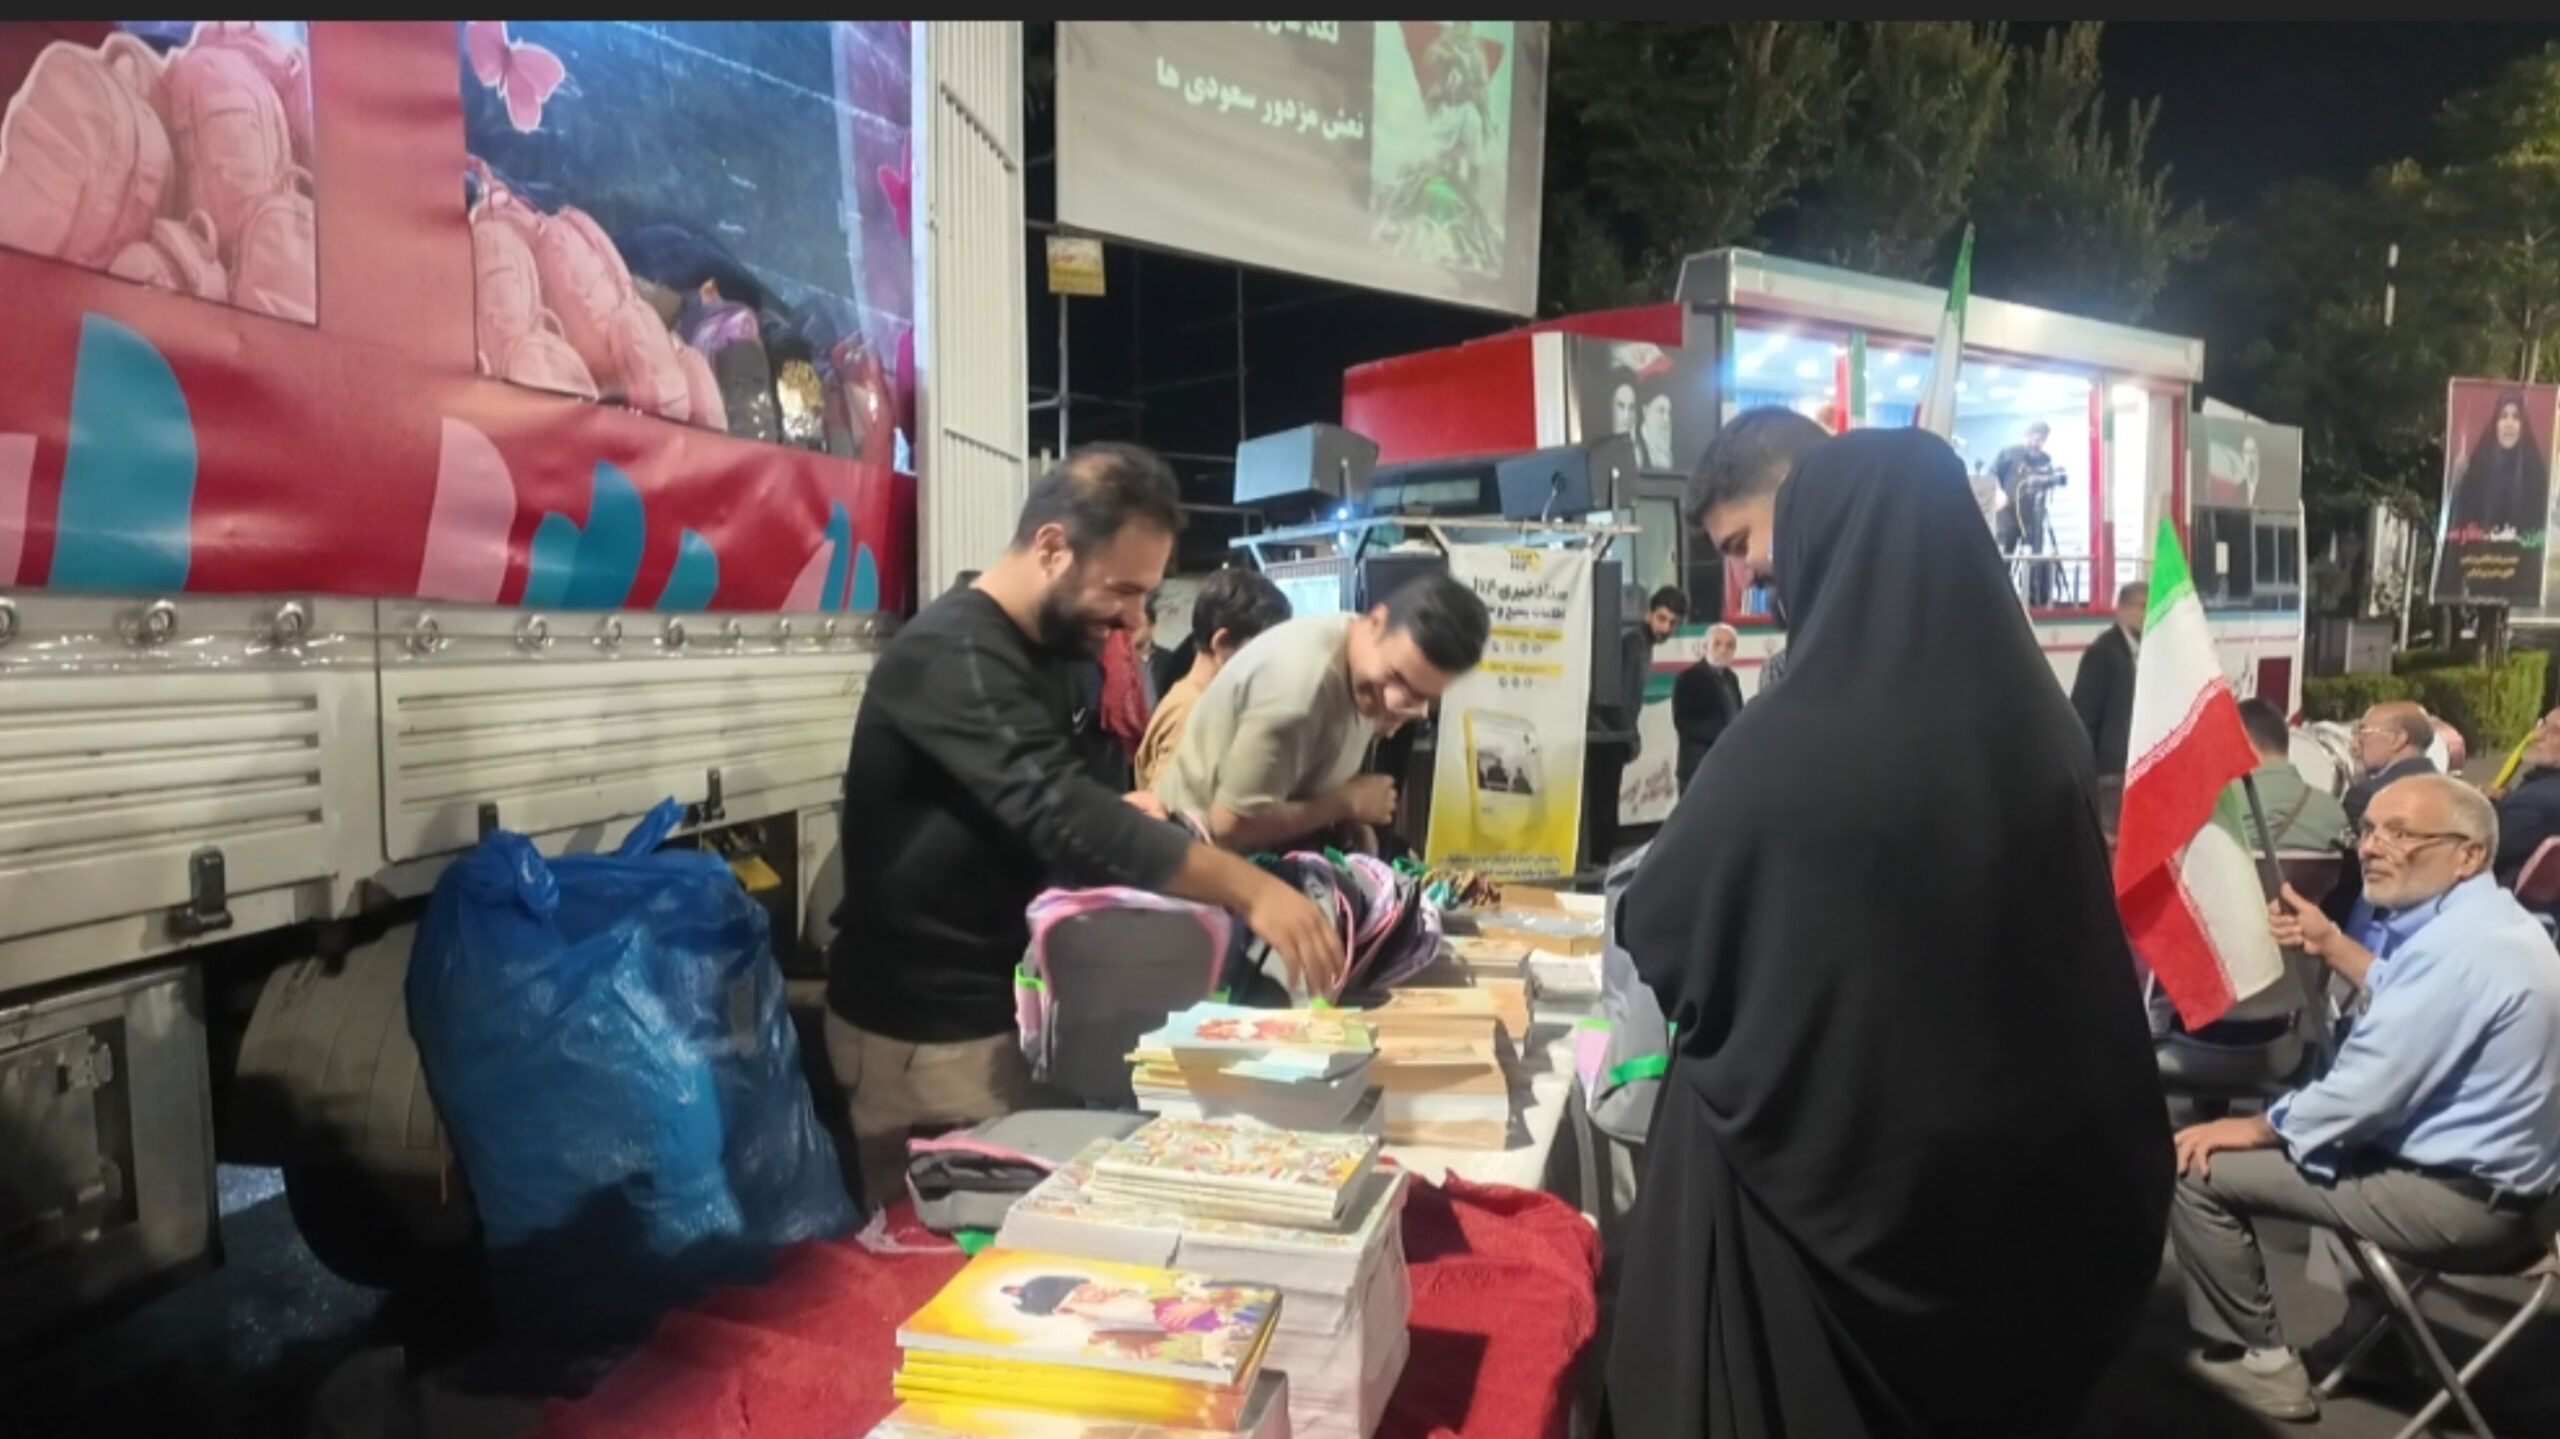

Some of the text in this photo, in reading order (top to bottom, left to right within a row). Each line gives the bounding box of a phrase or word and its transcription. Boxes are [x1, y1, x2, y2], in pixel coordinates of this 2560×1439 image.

[1157, 56, 1364, 140] نعش مزدور سعودی ها
